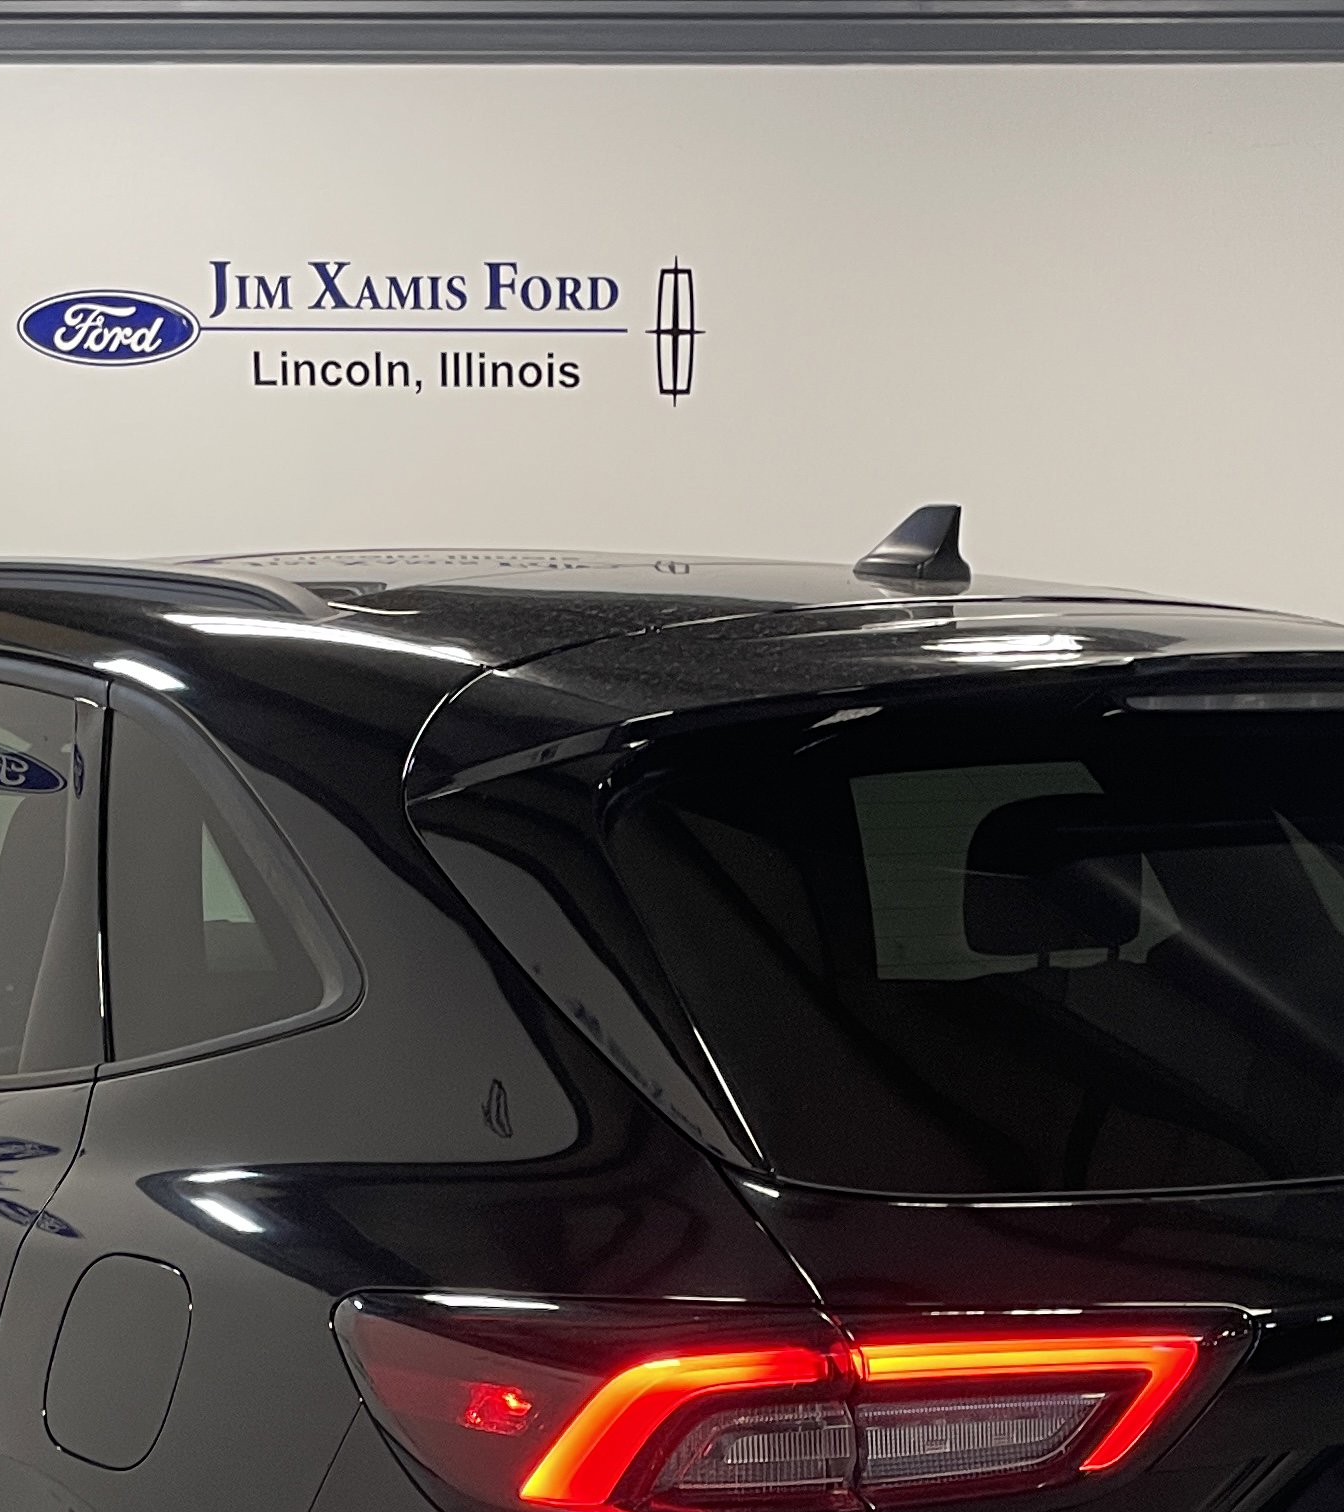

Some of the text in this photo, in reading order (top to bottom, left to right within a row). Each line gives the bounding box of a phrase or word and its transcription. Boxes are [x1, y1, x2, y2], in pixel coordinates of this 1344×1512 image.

[209, 260, 620, 317] JIM XAMIS FORD
[53, 302, 164, 354] Ford
[252, 350, 581, 394] Lincoln, Illinois
